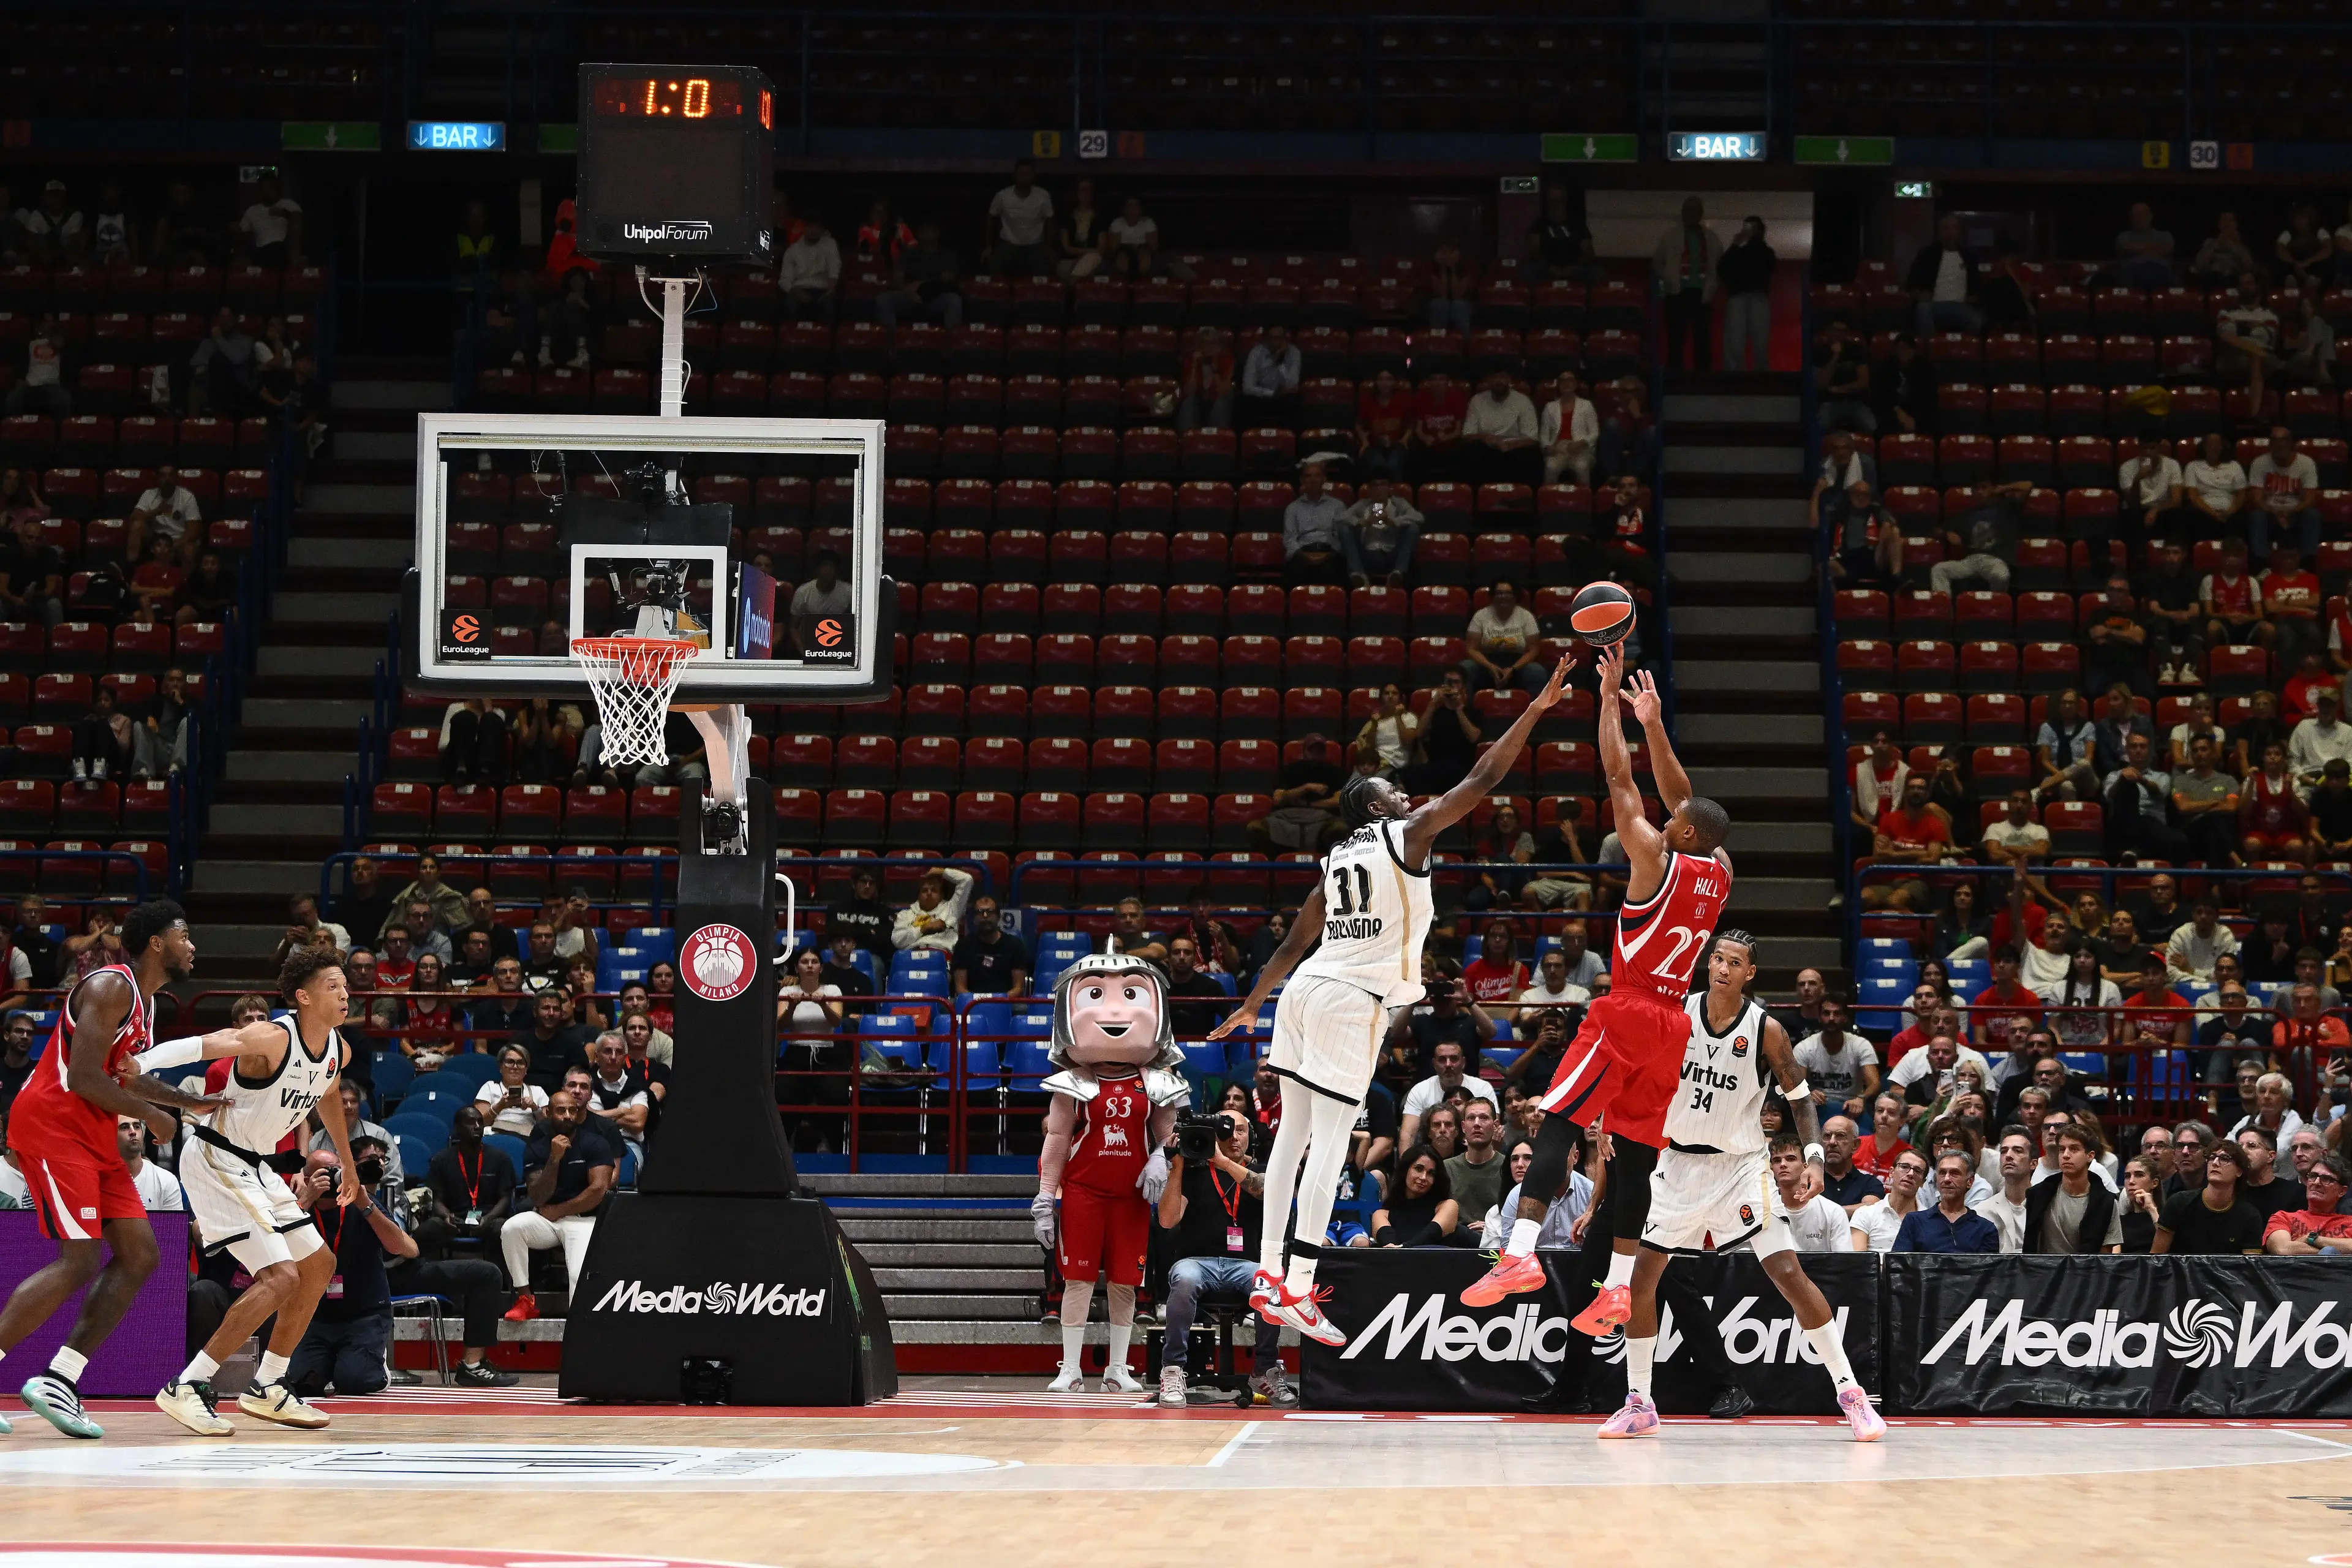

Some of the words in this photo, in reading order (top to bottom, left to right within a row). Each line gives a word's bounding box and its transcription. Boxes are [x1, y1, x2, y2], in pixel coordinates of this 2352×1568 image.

[432, 125, 478, 147] BAR
[1082, 135, 1106, 153] 29
[1695, 136, 1741, 159] BAR
[2192, 146, 2215, 162] 30
[624, 224, 709, 243] UnipolForum
[750, 609, 770, 649] motorola
[442, 646, 489, 655] EuroLeague
[805, 650, 852, 659] EuroLeague
[1333, 863, 1373, 917] 31
[1694, 877, 1718, 898] HALL
[1003, 912, 1015, 929] 9
[1326, 918, 1382, 940] BOLOGNA
[695, 926, 741, 943] OLIMPIA
[1649, 925, 1711, 982] 22
[699, 982, 739, 998] MILANO
[1679, 1061, 1738, 1091] Virtus
[281, 1088, 322, 1109] Virtus
[1106, 1096, 1132, 1118] 83
[1691, 1087, 1714, 1114] 34
[285, 1112, 301, 1129] 9
[592, 1280, 703, 1313] Media
[735, 1283, 826, 1316] World
[1920, 1298, 2158, 1369] Media
[2234, 1301, 2352, 1370] Wo
